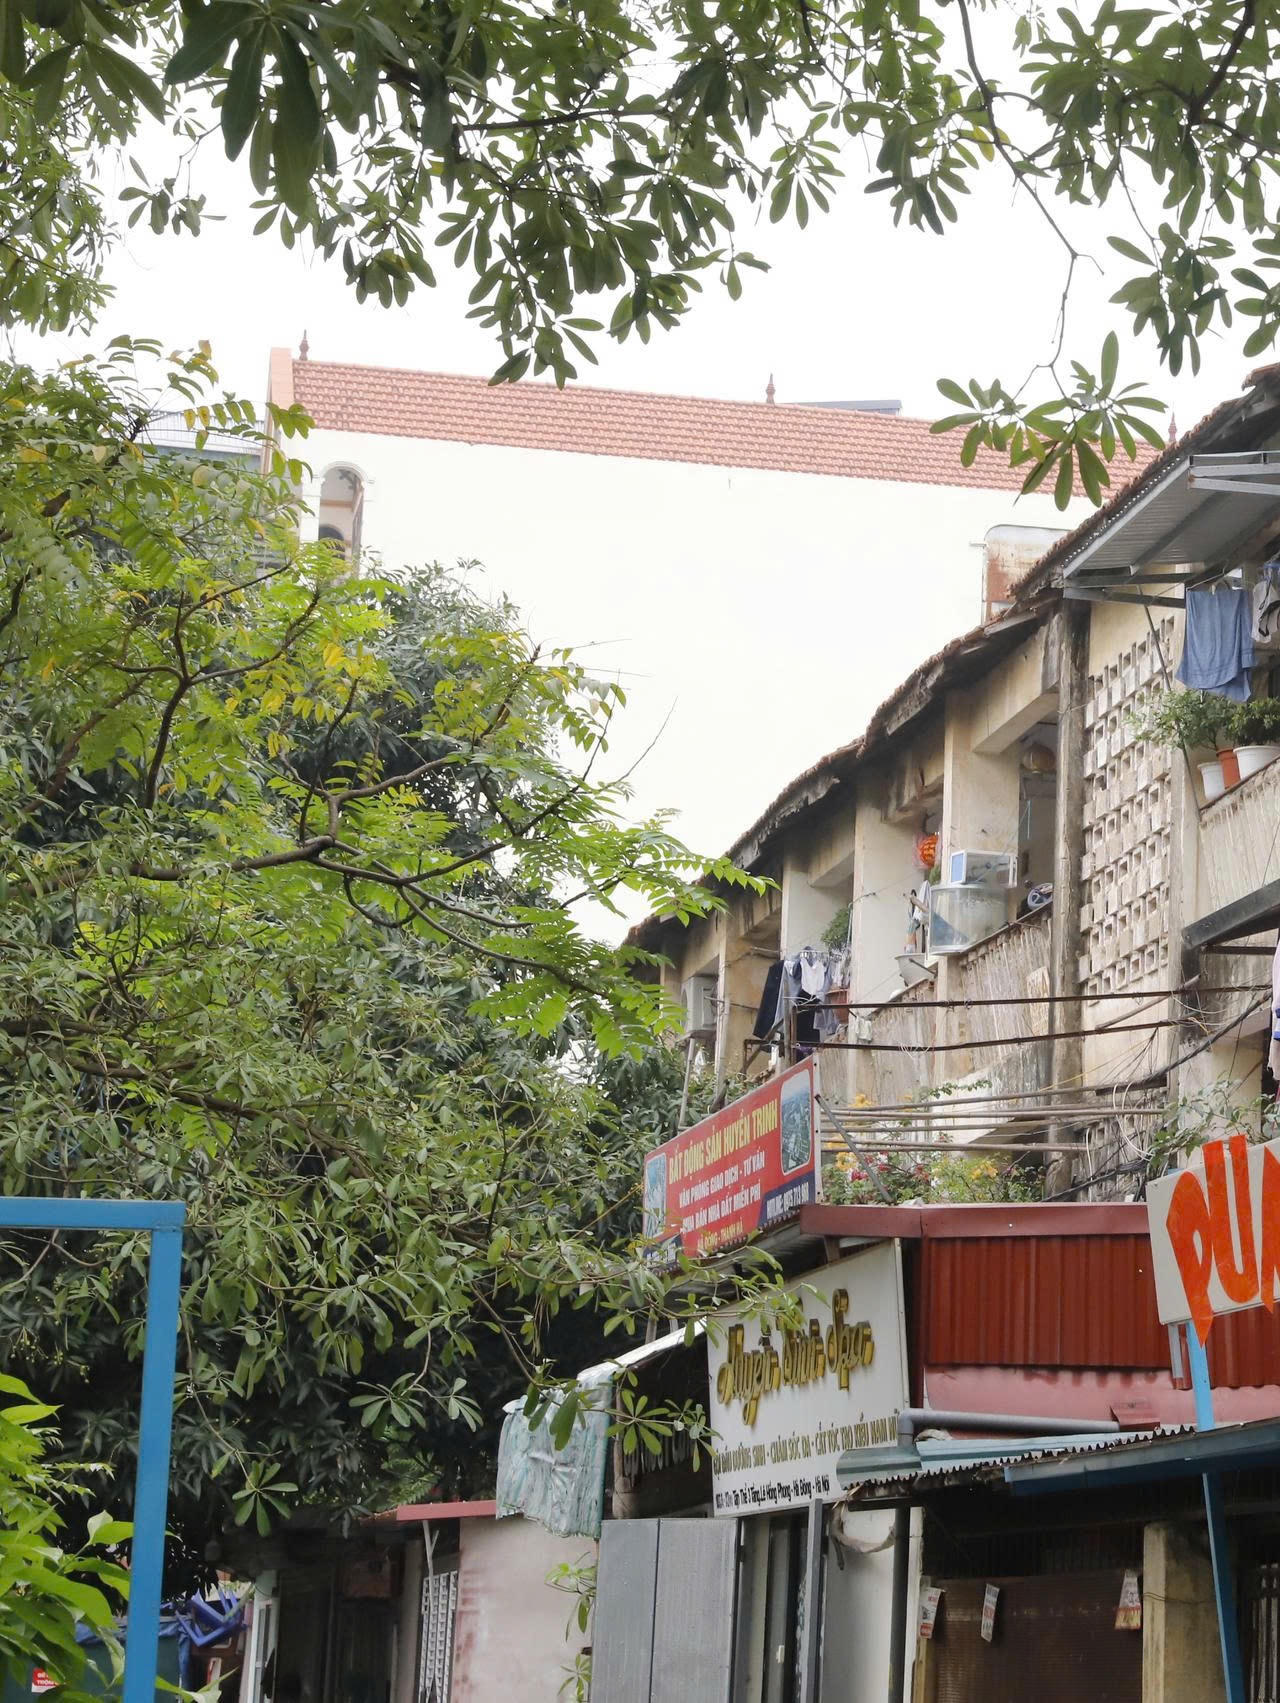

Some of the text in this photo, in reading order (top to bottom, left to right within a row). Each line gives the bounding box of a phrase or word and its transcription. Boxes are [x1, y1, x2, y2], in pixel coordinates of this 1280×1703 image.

[669, 1099, 778, 1184] BẤT ĐỘNG SẢN HUYỀN TRINH
[825, 1287, 876, 1392] Spa
